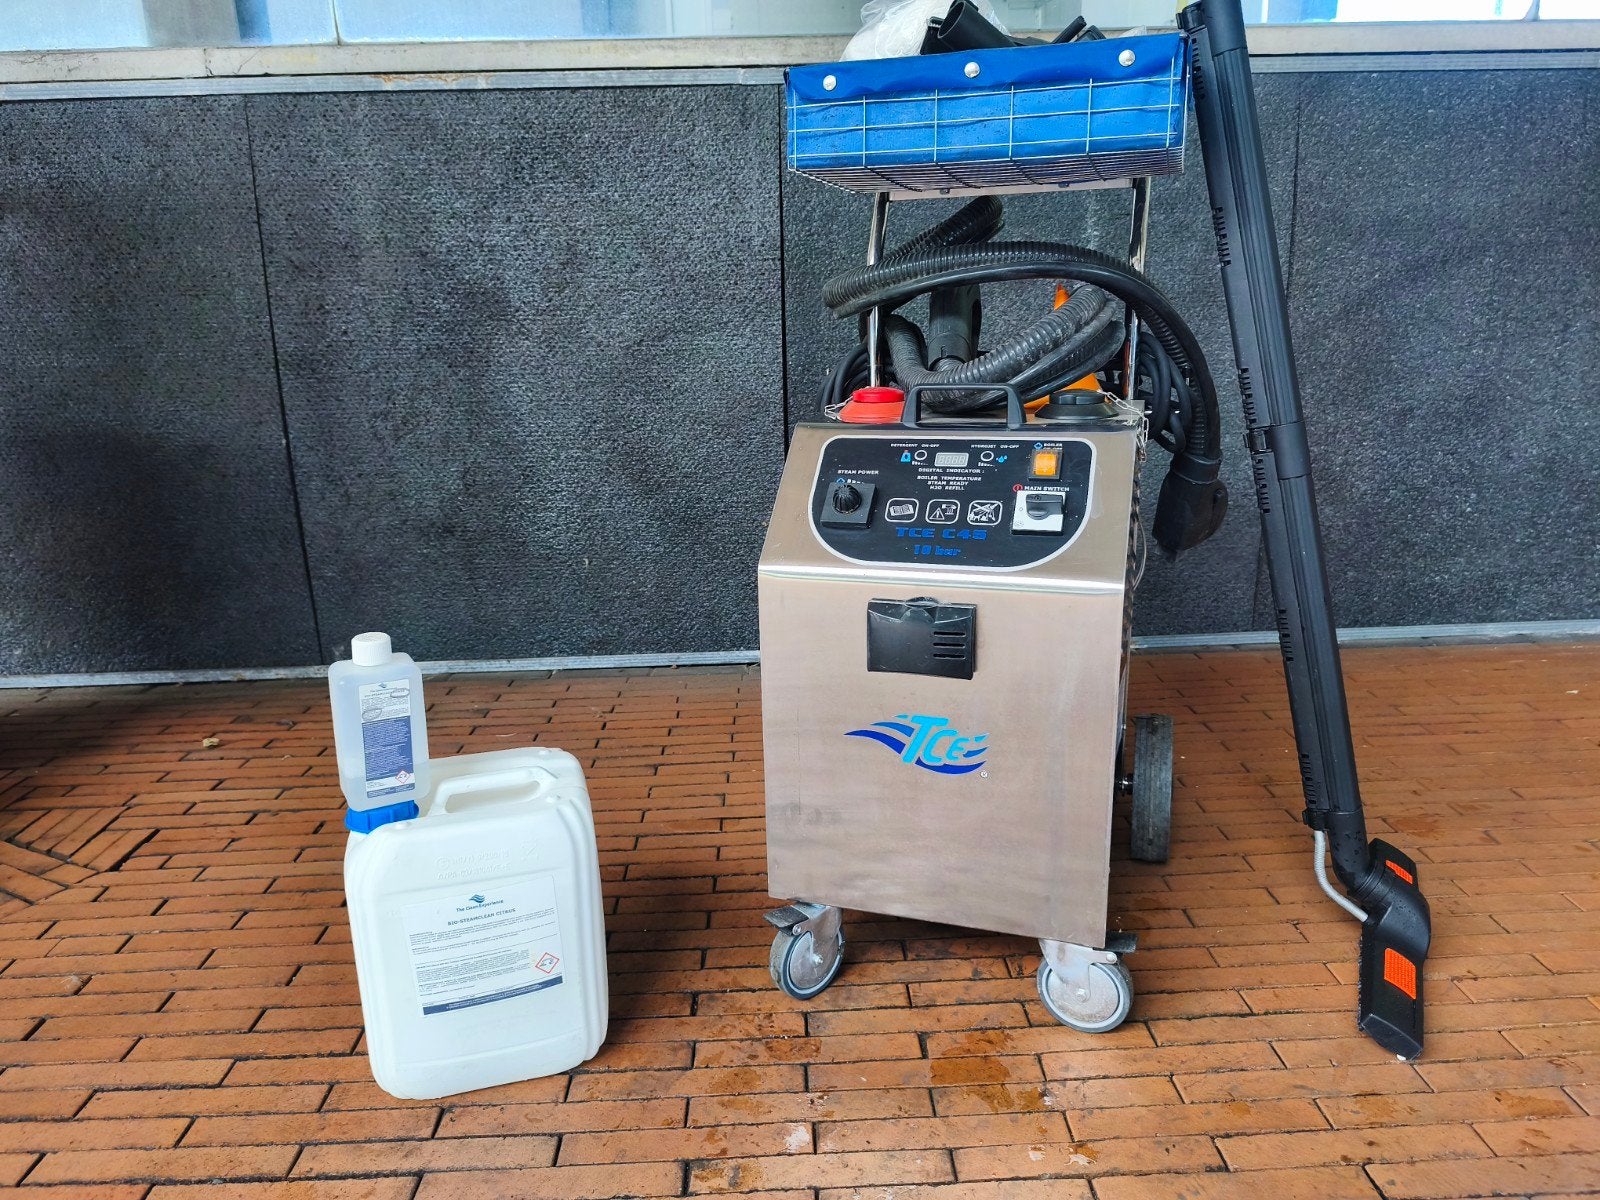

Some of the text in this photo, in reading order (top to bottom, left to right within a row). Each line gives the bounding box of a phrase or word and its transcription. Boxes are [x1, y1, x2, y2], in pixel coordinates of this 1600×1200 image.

[895, 526, 988, 541] TCE C45
[913, 544, 961, 556] 10 bar
[902, 714, 971, 764] TCE
[495, 907, 516, 916] CITRUS
